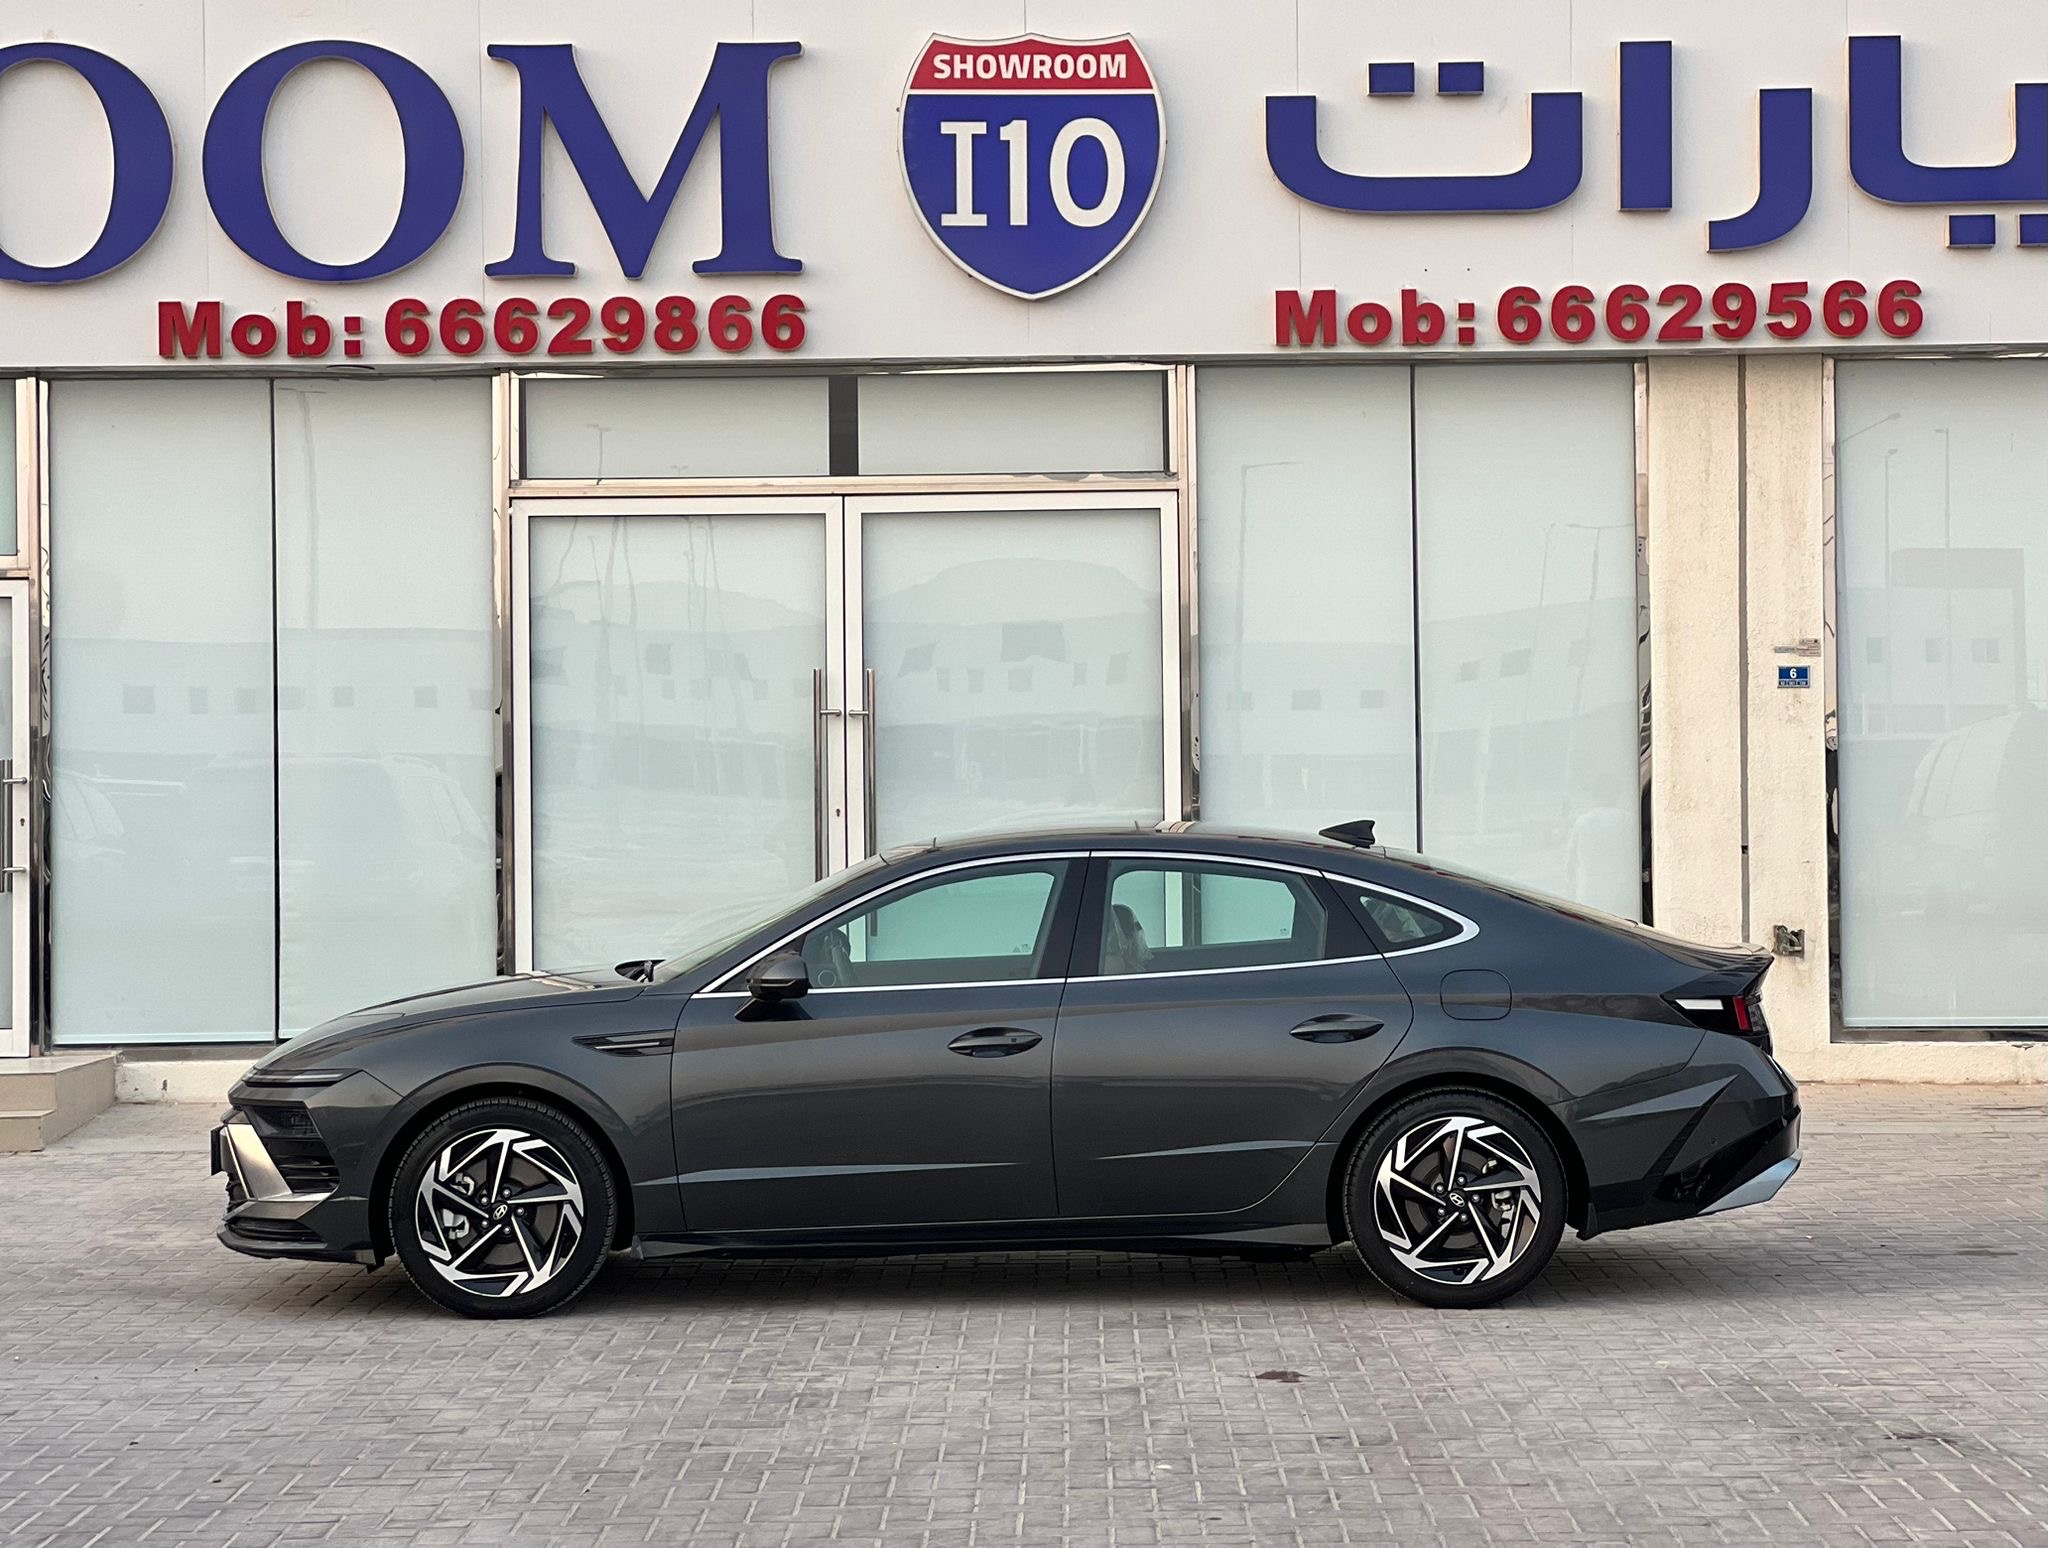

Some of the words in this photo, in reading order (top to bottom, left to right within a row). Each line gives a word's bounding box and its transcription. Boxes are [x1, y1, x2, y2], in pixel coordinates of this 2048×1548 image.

[933, 53, 1127, 80] SHOWROOM
[940, 117, 1126, 228] I10
[158, 301, 363, 357] Mob:
[385, 294, 807, 356] 66629866
[1275, 289, 1477, 346] Mob:
[1497, 280, 1925, 344] 66629566
[1789, 668, 1797, 678] 6
